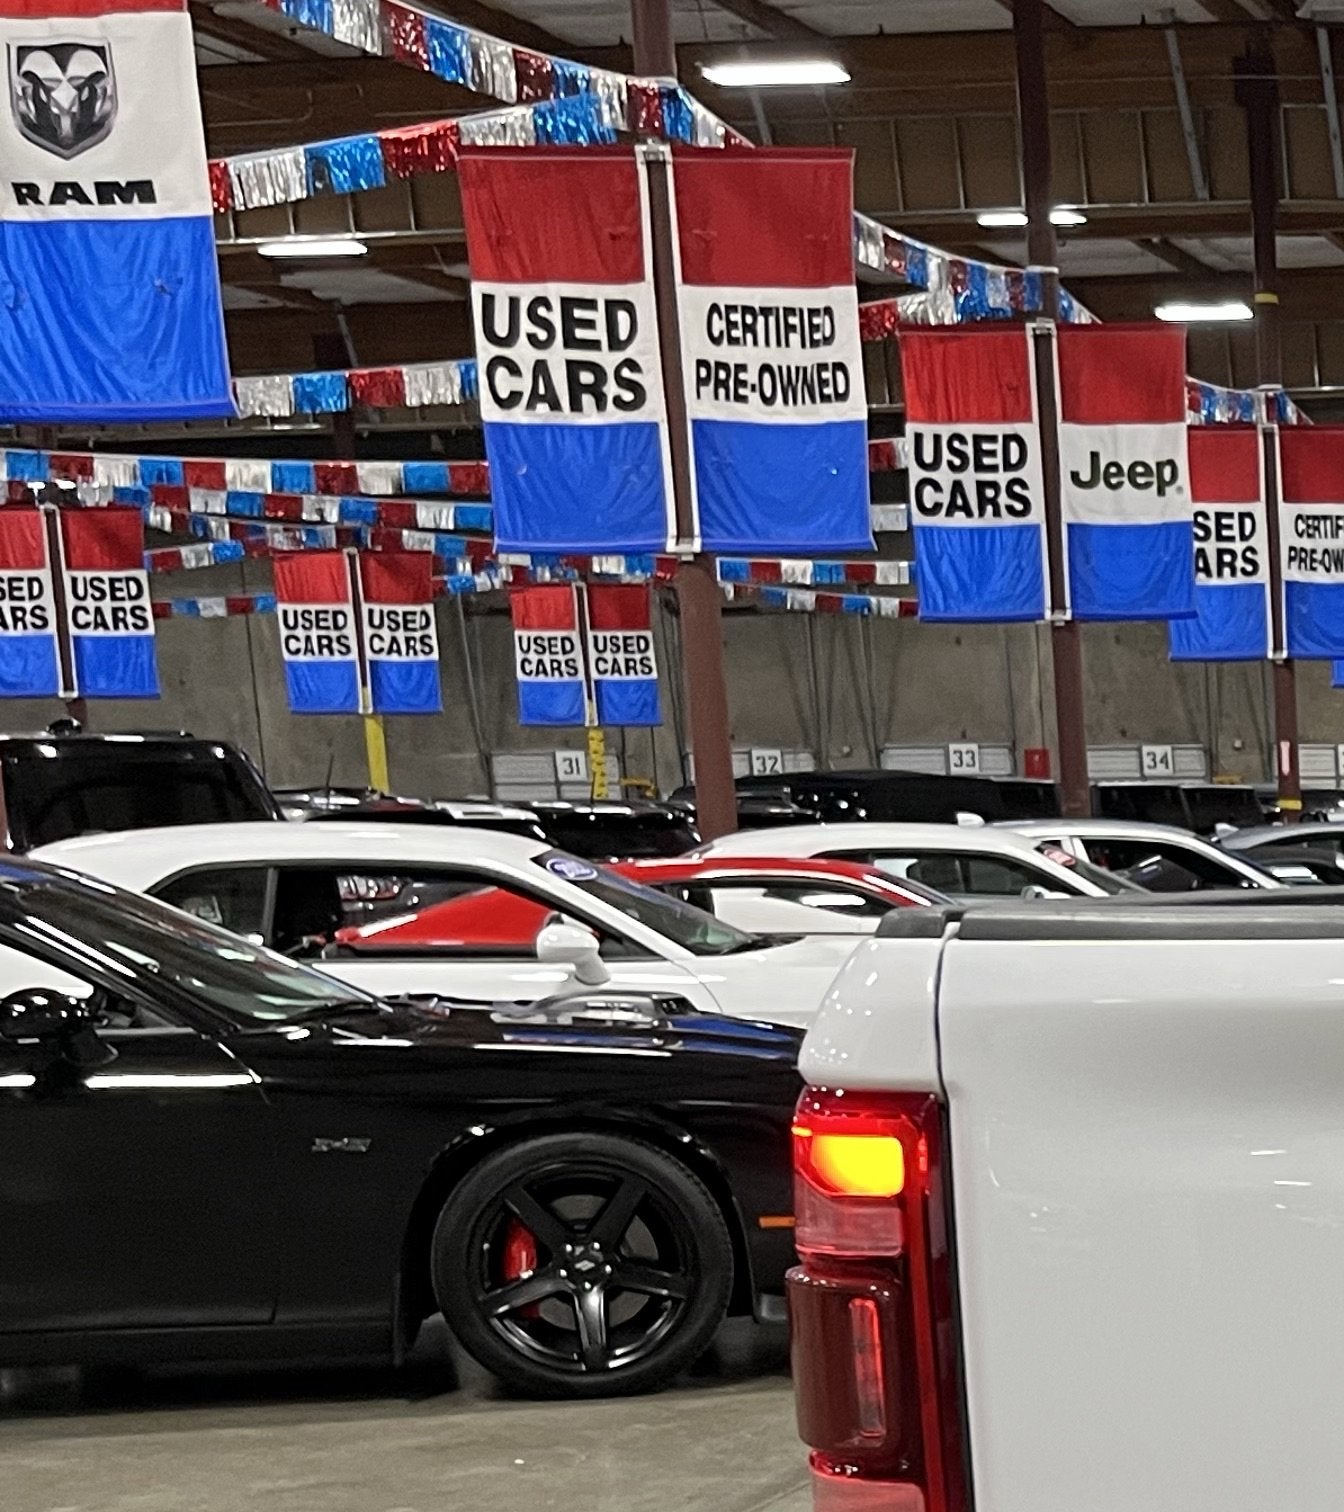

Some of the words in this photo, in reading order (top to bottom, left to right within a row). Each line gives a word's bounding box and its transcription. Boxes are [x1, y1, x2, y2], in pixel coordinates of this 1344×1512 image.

[11, 180, 157, 206] RAM
[481, 293, 638, 352] USED
[707, 302, 835, 349] CERTIFIED
[486, 355, 647, 412] CARS
[696, 359, 851, 406] PRE-OWNED
[914, 432, 1029, 473] USED
[1070, 451, 1179, 497] Jeep
[915, 477, 1032, 518] CARS
[1193, 511, 1256, 542] SED
[1195, 546, 1260, 578] ARS
[71, 576, 144, 602] USED
[71, 605, 149, 630] CARS
[282, 609, 348, 631] USED
[368, 608, 431, 632] USED
[284, 634, 351, 656] CARS
[369, 633, 434, 656] CARS
[518, 635, 575, 655] USED
[593, 635, 649, 654] USED
[520, 657, 578, 677] CARS
[595, 656, 653, 676] CARS
[563, 757, 580, 775] 31
[755, 755, 780, 774] 32
[953, 750, 977, 768] 33
[1146, 752, 1170, 769] 34
